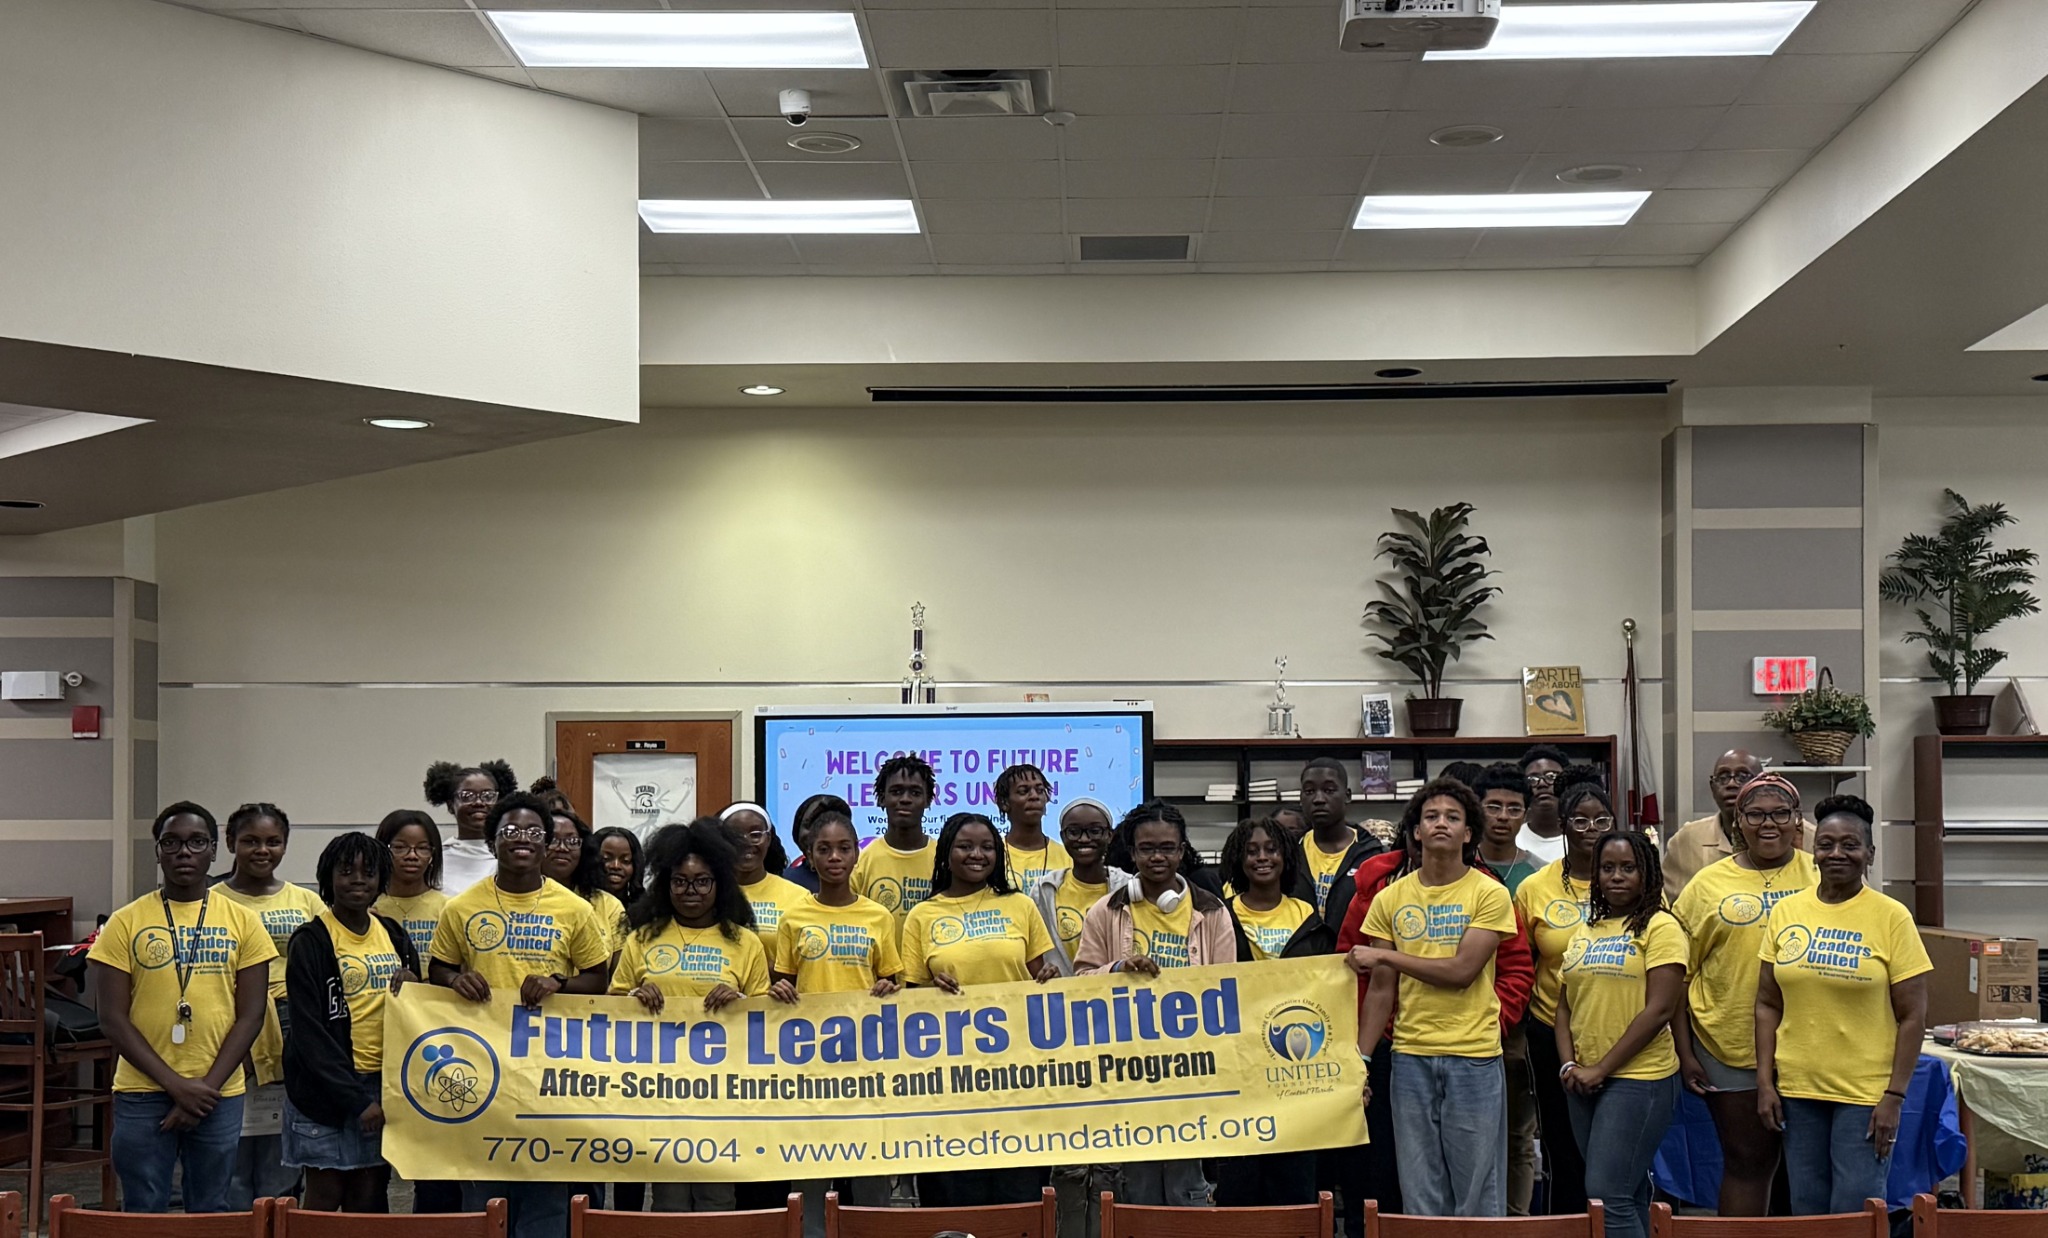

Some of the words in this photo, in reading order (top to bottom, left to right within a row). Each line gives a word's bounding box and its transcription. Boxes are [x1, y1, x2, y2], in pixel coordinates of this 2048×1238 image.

[1765, 659, 1807, 691] EXIT
[951, 749, 980, 773] TO
[988, 749, 1079, 773] FUTURE
[847, 782, 958, 806] LERS
[964, 909, 1001, 920] Future
[1427, 904, 1463, 914] Future
[965, 917, 1012, 929] Leaders
[1428, 914, 1471, 926] Leaders
[508, 924, 561, 939] Leaders
[830, 923, 867, 934] Future
[967, 925, 1006, 937] United
[1428, 925, 1464, 937] United
[1815, 926, 1863, 942] Future
[507, 936, 552, 951] United
[831, 945, 868, 957] United
[1151, 942, 1188, 958] Leade
[1586, 942, 1636, 956] Leaders
[1810, 939, 1872, 957] Leaders
[1583, 953, 1625, 966] United
[1807, 951, 1859, 969] United
[510, 1004, 727, 1065] Future
[747, 1003, 1007, 1065] Leaders
[1026, 977, 1241, 1050] United
[539, 1068, 718, 1100] After-School
[726, 1072, 886, 1100] Enrichment
[892, 1066, 943, 1096] and
[950, 1058, 1092, 1094] Mentoring
[1098, 1050, 1216, 1087] Program
[1266, 1062, 1341, 1082] UNITED
[1267, 1078, 1341, 1089] FOUNDATION
[483, 1136, 741, 1164] 770-789-7004
[779, 1115, 1277, 1163] www.unitedfoundationcf.org
